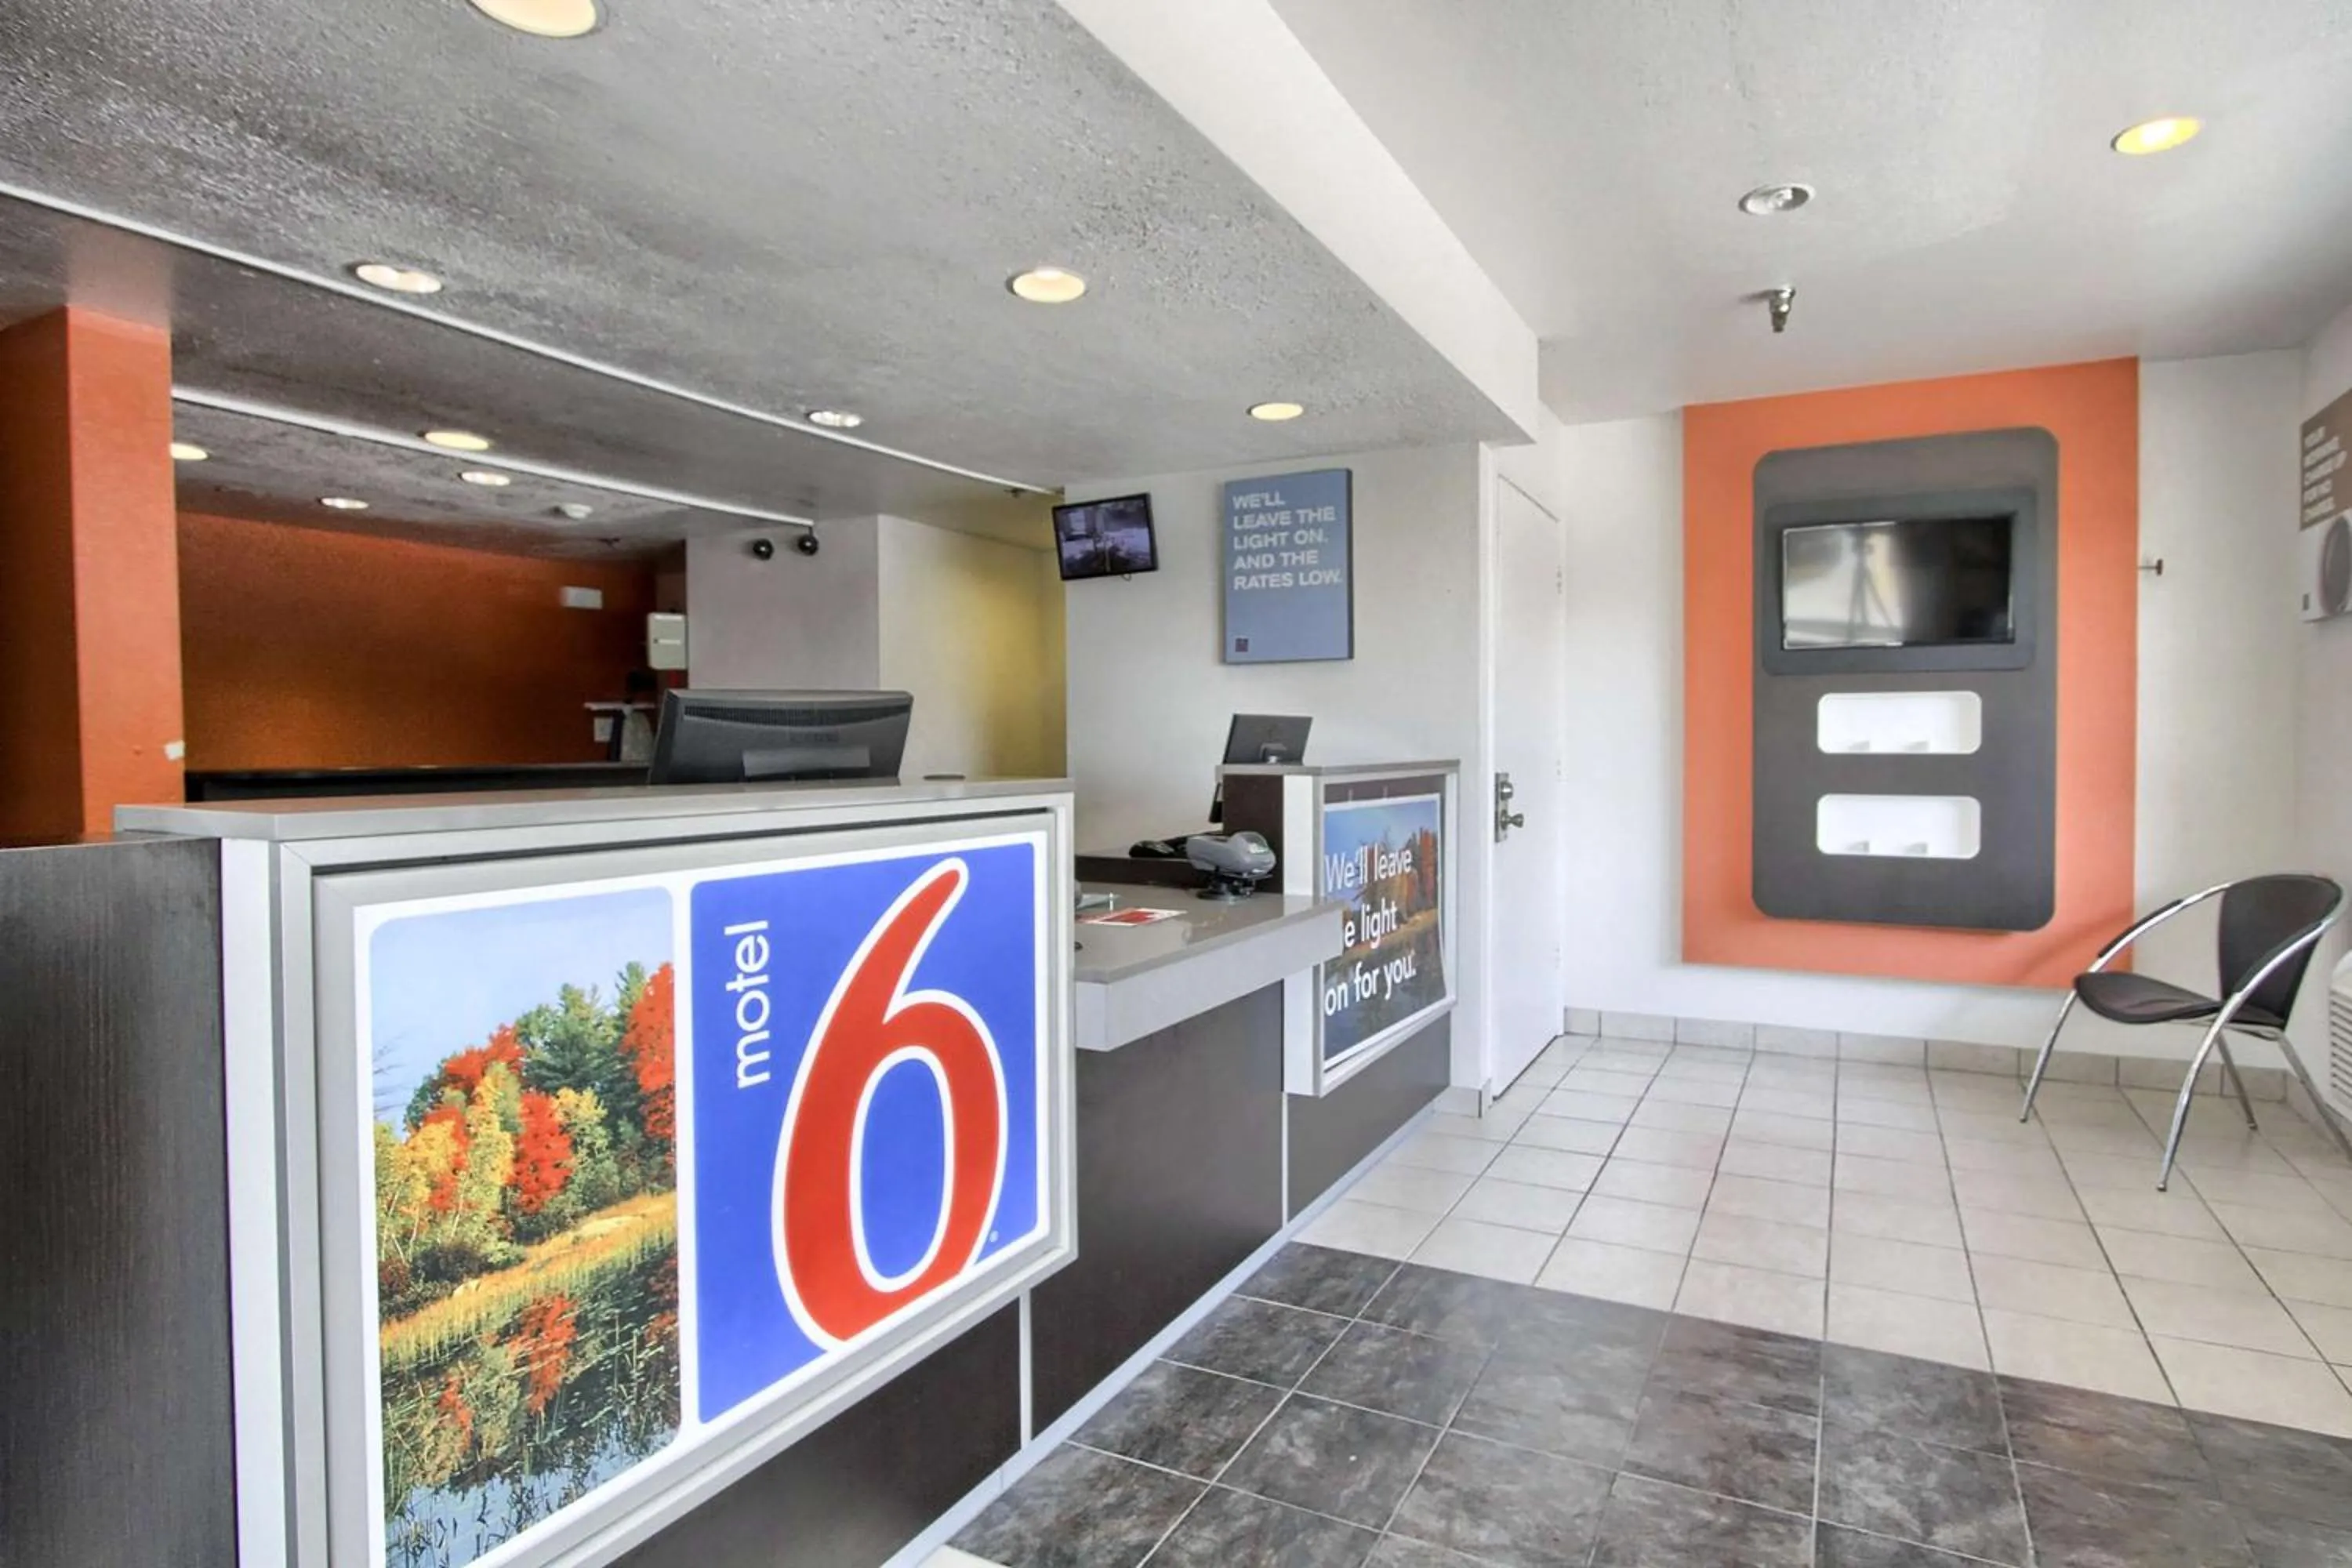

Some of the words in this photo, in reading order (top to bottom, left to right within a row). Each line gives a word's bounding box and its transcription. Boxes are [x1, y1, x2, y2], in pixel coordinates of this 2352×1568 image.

[1232, 491, 1286, 510] WE'LL
[1234, 510, 1292, 530] LEAVE
[1295, 506, 1336, 524] THE
[1234, 532, 1290, 550] LIGHT
[1234, 553, 1275, 571] AND
[1279, 550, 1319, 567] THE
[1233, 572, 1294, 590] RATES
[1325, 845, 1368, 893] We'll
[1374, 843, 1413, 882] leave
[1360, 897, 1398, 949] light
[1324, 982, 1348, 1016] on
[1353, 960, 1380, 1004] for
[724, 919, 771, 1090] motel
[771, 856, 1008, 1355] 6
